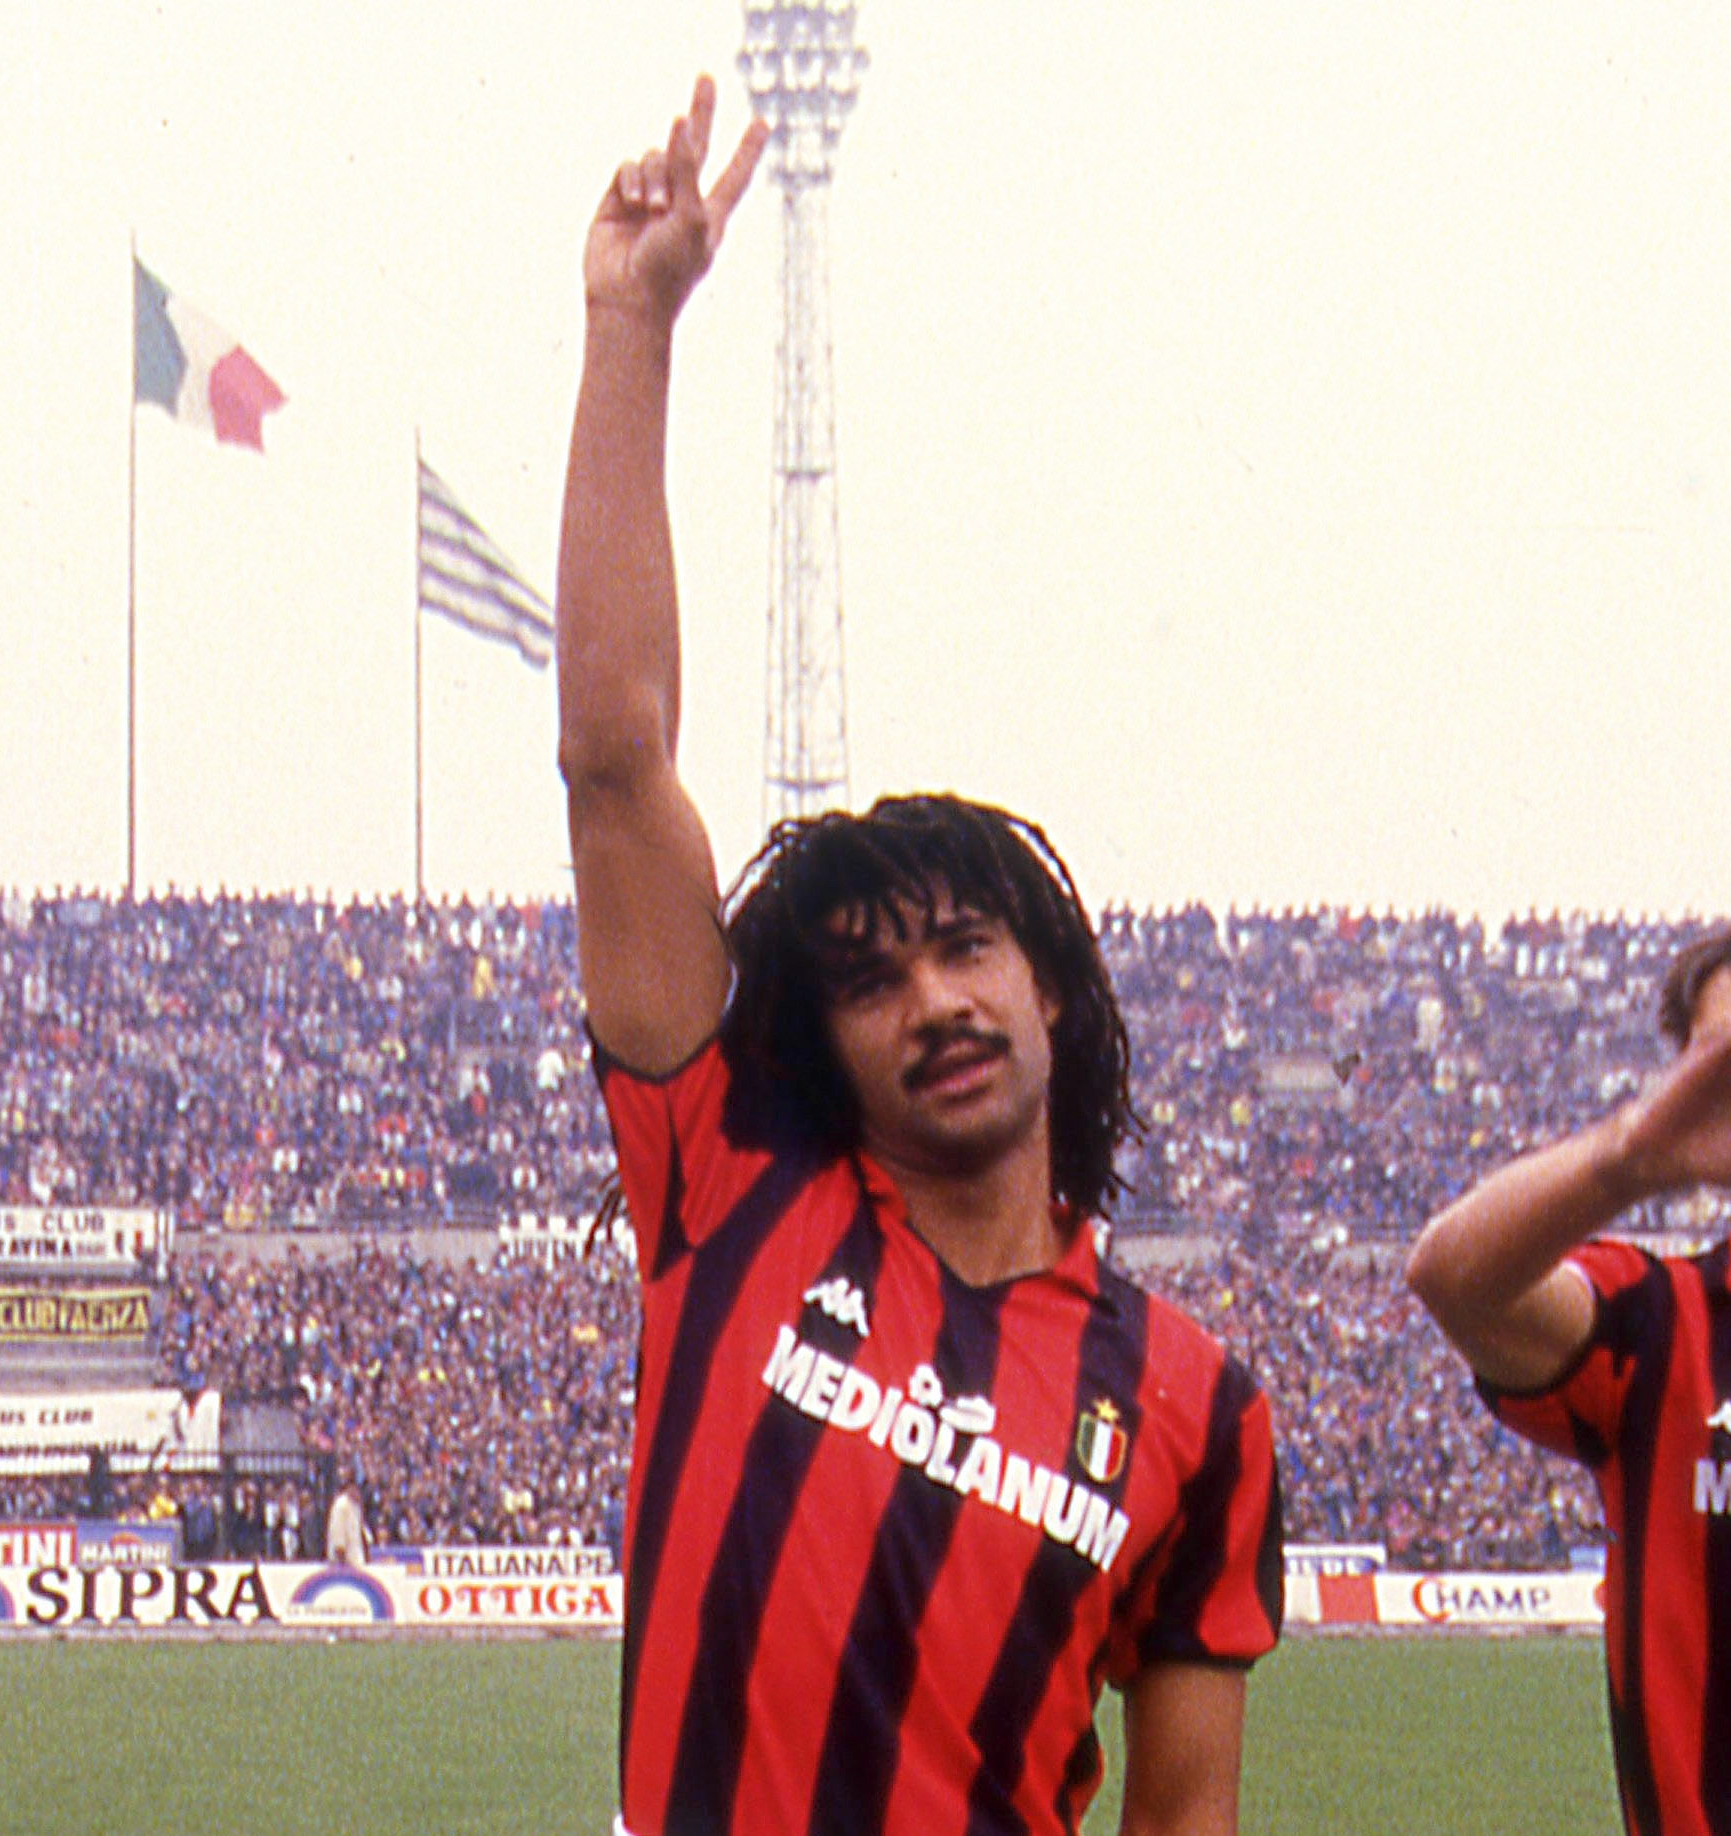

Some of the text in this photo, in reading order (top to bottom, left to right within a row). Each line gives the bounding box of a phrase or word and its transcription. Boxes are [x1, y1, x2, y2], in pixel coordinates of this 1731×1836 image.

[41, 1213, 106, 1232] CLUB
[38, 1408, 94, 1425] CLUB
[762, 1325, 1130, 1573] MEDIOLANUM
[80, 1543, 169, 1567] MARTINI
[433, 1552, 566, 1577] ITALIANA
[26, 1566, 271, 1626] SIPRA
[417, 1583, 615, 1618] OTTIGA
